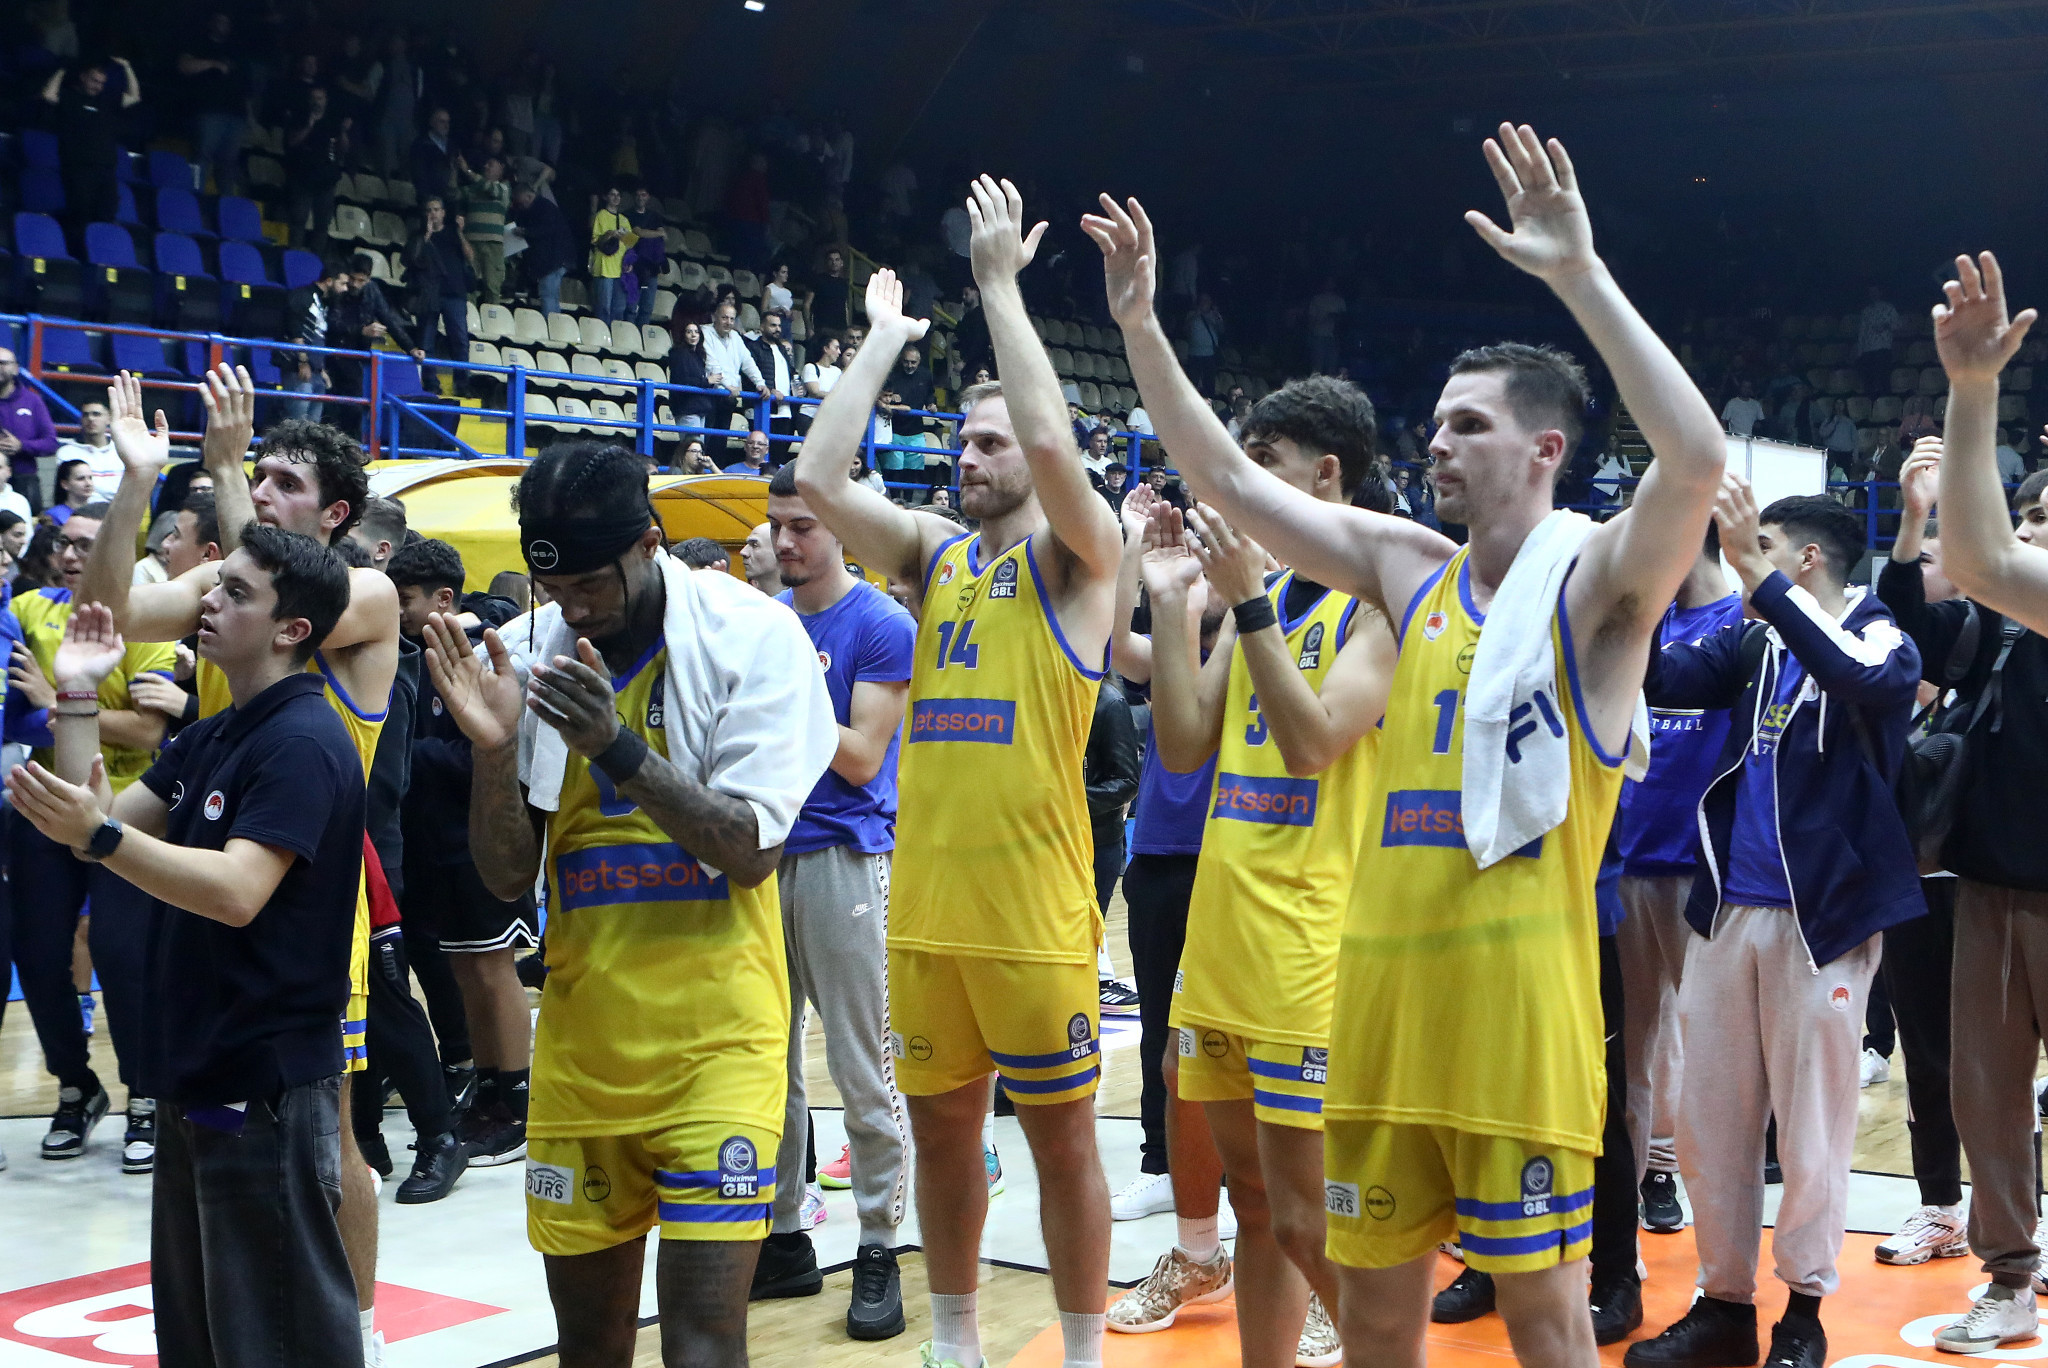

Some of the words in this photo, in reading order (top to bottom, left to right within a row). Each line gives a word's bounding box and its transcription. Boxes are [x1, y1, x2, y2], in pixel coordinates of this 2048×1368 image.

[991, 586, 1015, 597] GBL
[936, 619, 980, 670] 14
[914, 709, 1005, 733] etsson
[1431, 689, 1465, 755] 1
[1216, 785, 1310, 815] etsson
[854, 902, 869, 912] NIKE
[1072, 1044, 1092, 1058] GBL
[721, 1173, 757, 1183] Stoiximan
[722, 1182, 757, 1196] GBL
[1523, 1200, 1550, 1216] GBL
